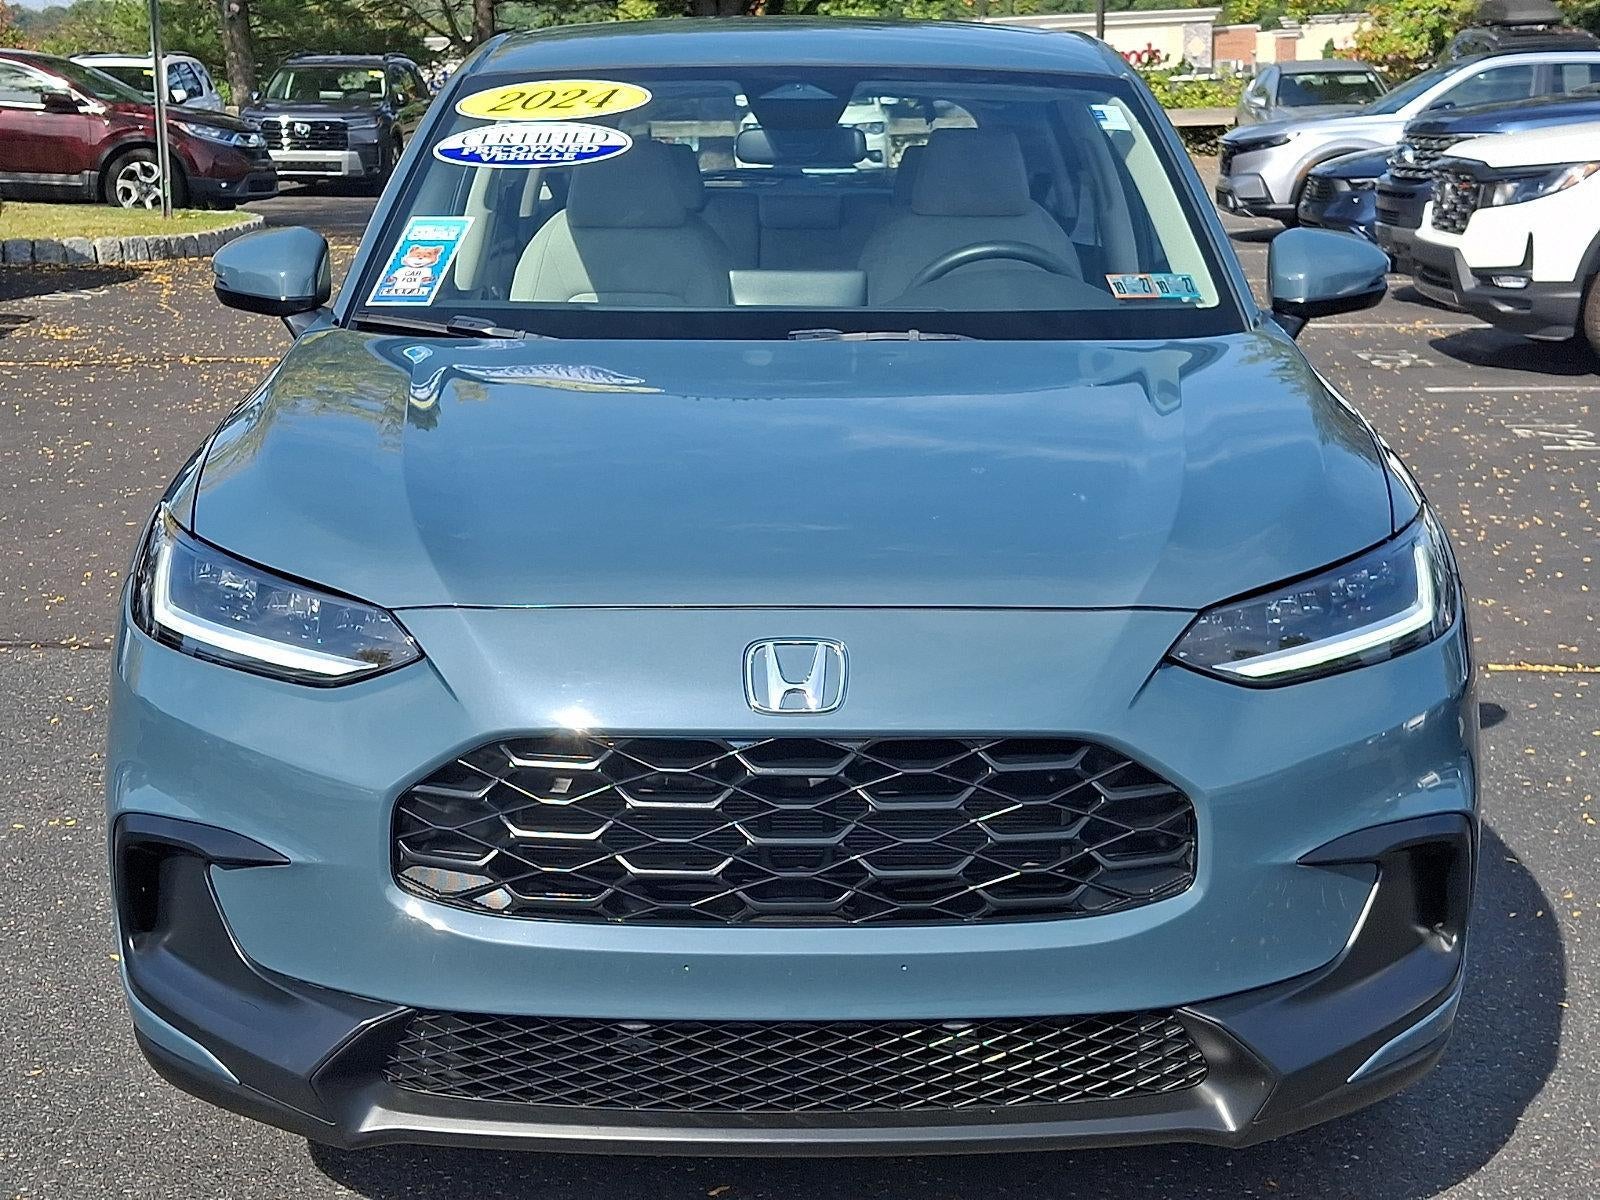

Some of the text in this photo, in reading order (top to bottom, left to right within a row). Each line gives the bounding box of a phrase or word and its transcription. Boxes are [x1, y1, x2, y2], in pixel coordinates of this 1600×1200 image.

[487, 88, 620, 113] 2024
[461, 132, 610, 146] CERTIFIED
[460, 144, 601, 156] PRE-OWNED
[480, 152, 578, 162] VEHICLE
